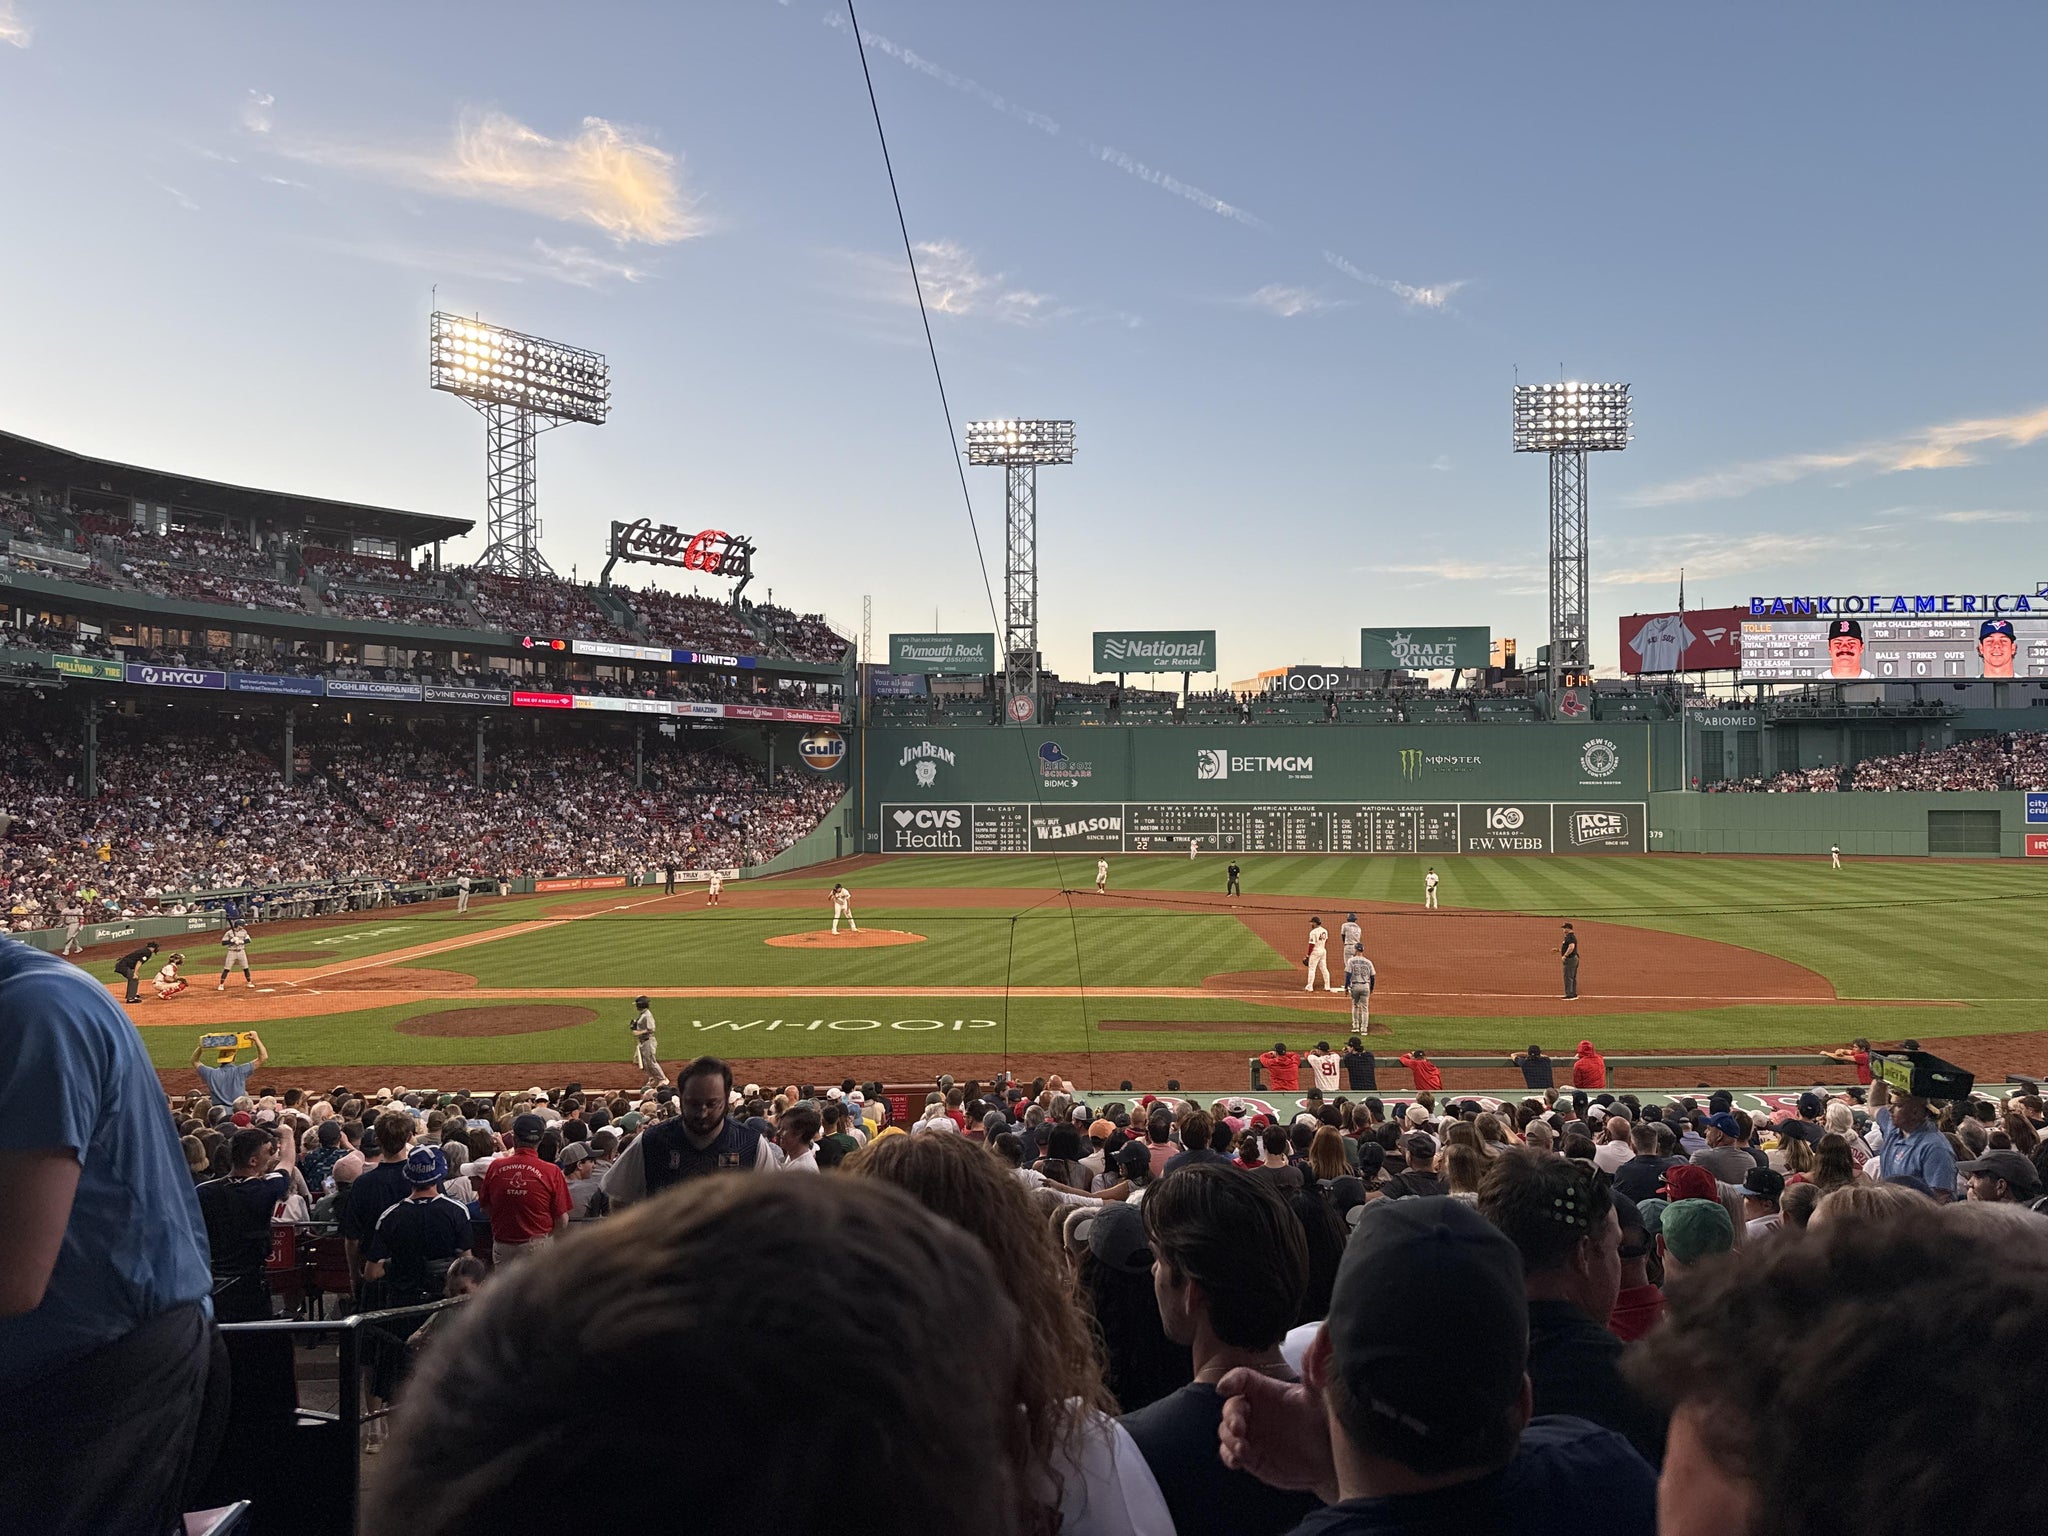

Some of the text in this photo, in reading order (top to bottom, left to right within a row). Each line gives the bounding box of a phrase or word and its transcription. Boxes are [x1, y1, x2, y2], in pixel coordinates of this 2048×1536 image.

[1749, 594, 2032, 615] BANK OF AMERICA
[1743, 624, 1771, 633] TOLLE
[1887, 620, 1933, 628] CHALLENGES
[1660, 634, 1676, 644] SOX
[1874, 630, 1889, 638] TOR
[579, 644, 615, 654] PITCH BREAK
[900, 644, 984, 658] Plymouth Rock
[1391, 642, 1457, 658] DRAFT
[701, 654, 738, 667] UNITED
[1400, 654, 1455, 666] KINGS
[1875, 651, 1965, 660] BALLS STRIKES OUTS
[1153, 657, 1201, 666] Car Rental
[1743, 659, 1791, 667] 2026 SEASON
[55, 661, 121, 678] SULLIVAN TIRE
[1758, 669, 1776, 677] 2.97
[1796, 669, 1812, 677] 1.08
[1883, 662, 1957, 675] 0 0 1
[2038, 667, 2044, 675] 7
[161, 671, 203, 684] HYCU
[873, 678, 890, 686] Your
[1257, 673, 1340, 691] WHOOP
[1565, 675, 1588, 687] 0:14
[328, 682, 420, 694] COGHLIN COMPANIES
[892, 686, 910, 694] team
[435, 690, 507, 701] VINEYARD VINES
[692, 705, 718, 714] AMAZING
[736, 708, 773, 717] Ninety Nine
[786, 711, 814, 720] Safelite
[1703, 716, 1757, 726] ABIOMED
[800, 740, 843, 756] Gulf
[1582, 738, 1617, 751] IBEW 103
[899, 741, 955, 767] JIM BEAM
[1044, 761, 1092, 770] RED SOX
[1231, 755, 1313, 772] BETMGM
[1425, 755, 1482, 765] MONSTER
[1044, 770, 1092, 778] SCHOLARS
[1044, 779, 1070, 788] BIDMC
[2028, 799, 2048, 808] city
[915, 809, 962, 829] CVS
[1486, 807, 1525, 829] 160
[1581, 813, 1621, 828] ACE
[1581, 826, 1622, 838] TICKET
[1649, 830, 1663, 838] 379
[895, 830, 962, 848] Health
[1469, 837, 1543, 850] F.W. WEBB
[1136, 841, 1148, 850] 22
[97, 928, 135, 939] ACE TICKET
[692, 1019, 997, 1031] WHOOP
[1321, 1062, 1337, 1076] 91
[498, 1163, 544, 1179] FENWAY PARK
[506, 1188, 528, 1196] STAFF
